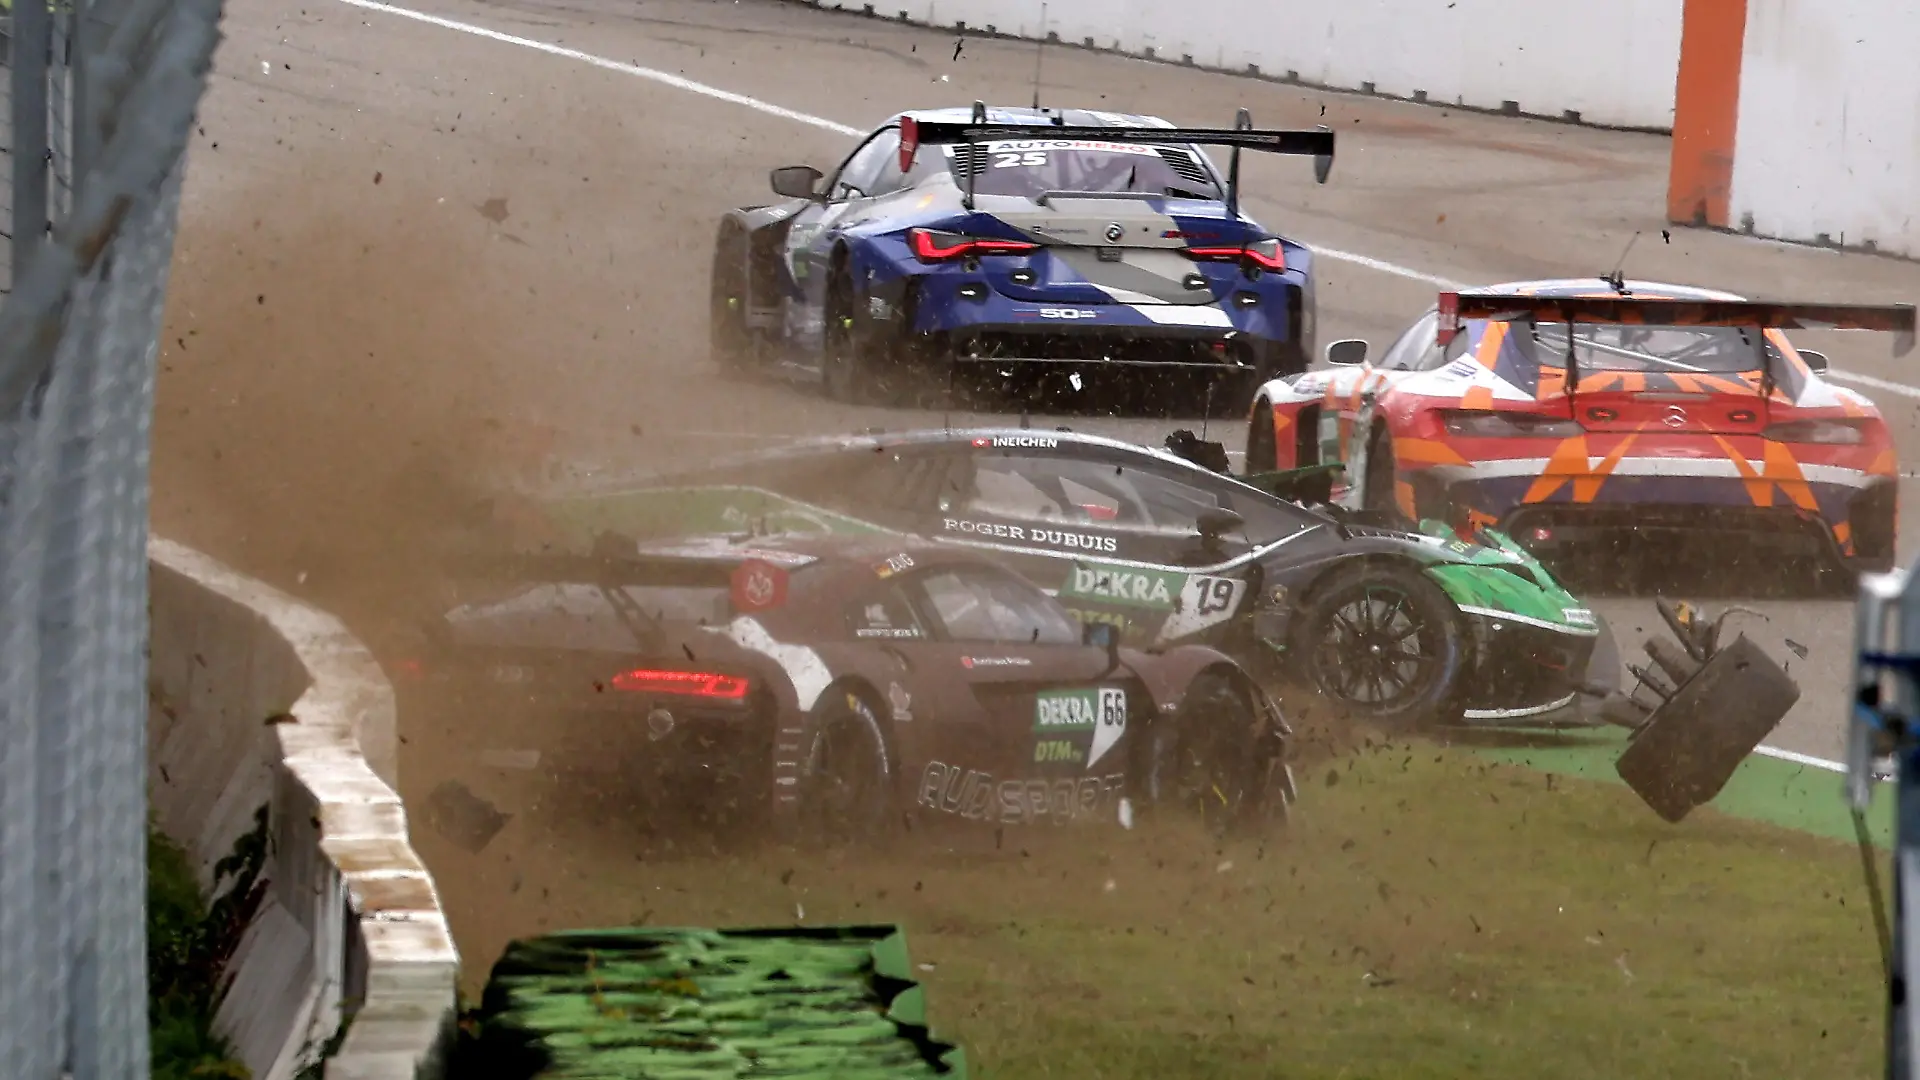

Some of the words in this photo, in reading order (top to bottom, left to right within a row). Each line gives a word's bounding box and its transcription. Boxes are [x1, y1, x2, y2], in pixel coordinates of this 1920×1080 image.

[993, 152, 1048, 169] 25
[996, 140, 1148, 153] AUTOHERO
[992, 436, 1058, 448] INEICHEN
[943, 517, 1026, 539] ROGER
[1031, 529, 1118, 552] DUBUIS
[1074, 567, 1171, 603] DEKRA
[1195, 577, 1234, 615] 19
[1036, 696, 1096, 725] DEKRA
[1103, 692, 1125, 727] 66
[1034, 740, 1073, 763] DTM
